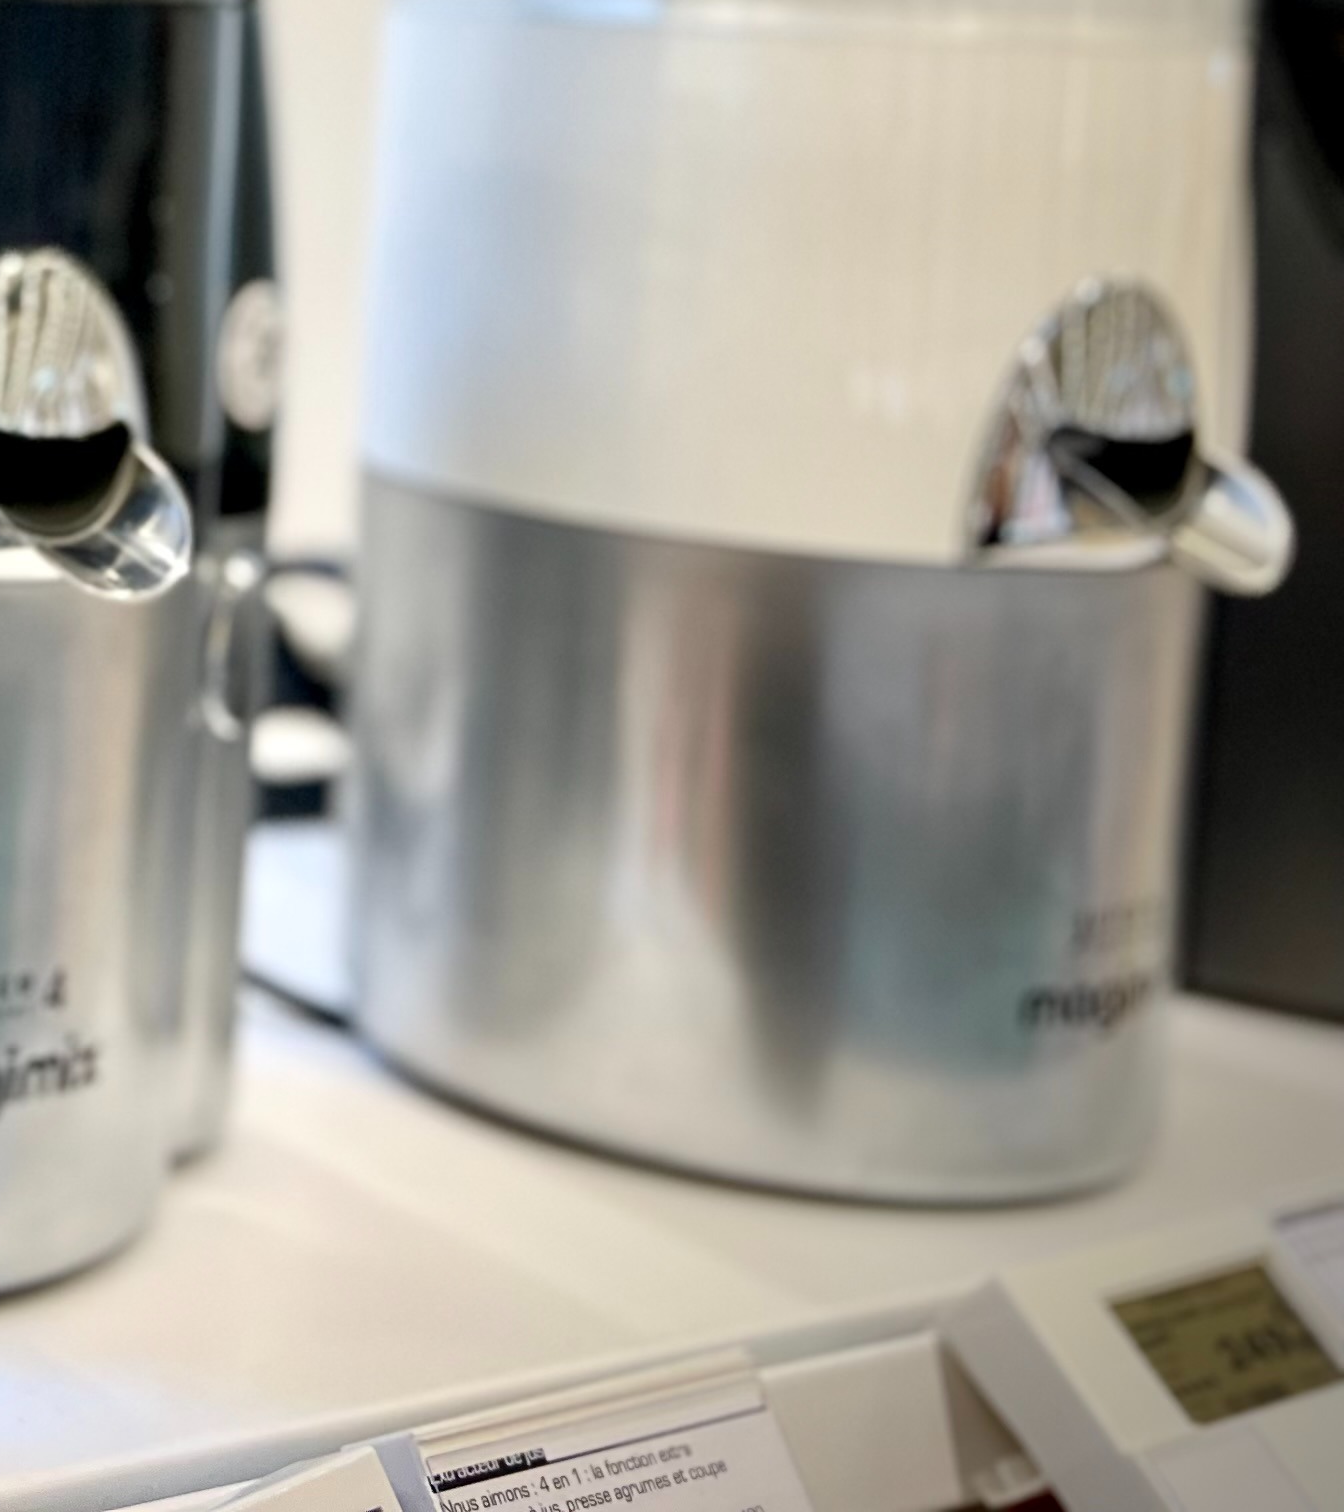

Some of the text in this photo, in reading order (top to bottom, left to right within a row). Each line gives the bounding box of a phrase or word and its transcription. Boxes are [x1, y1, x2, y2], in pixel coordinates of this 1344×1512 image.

[482, 1483, 530, 1509] aimons
[540, 1476, 549, 1492] 4
[553, 1474, 570, 1489] en
[571, 1467, 582, 1485] 1
[590, 1464, 604, 1480] la
[605, 1452, 657, 1476] fonction
[566, 1459, 727, 1512] presse agrumes et coupe
